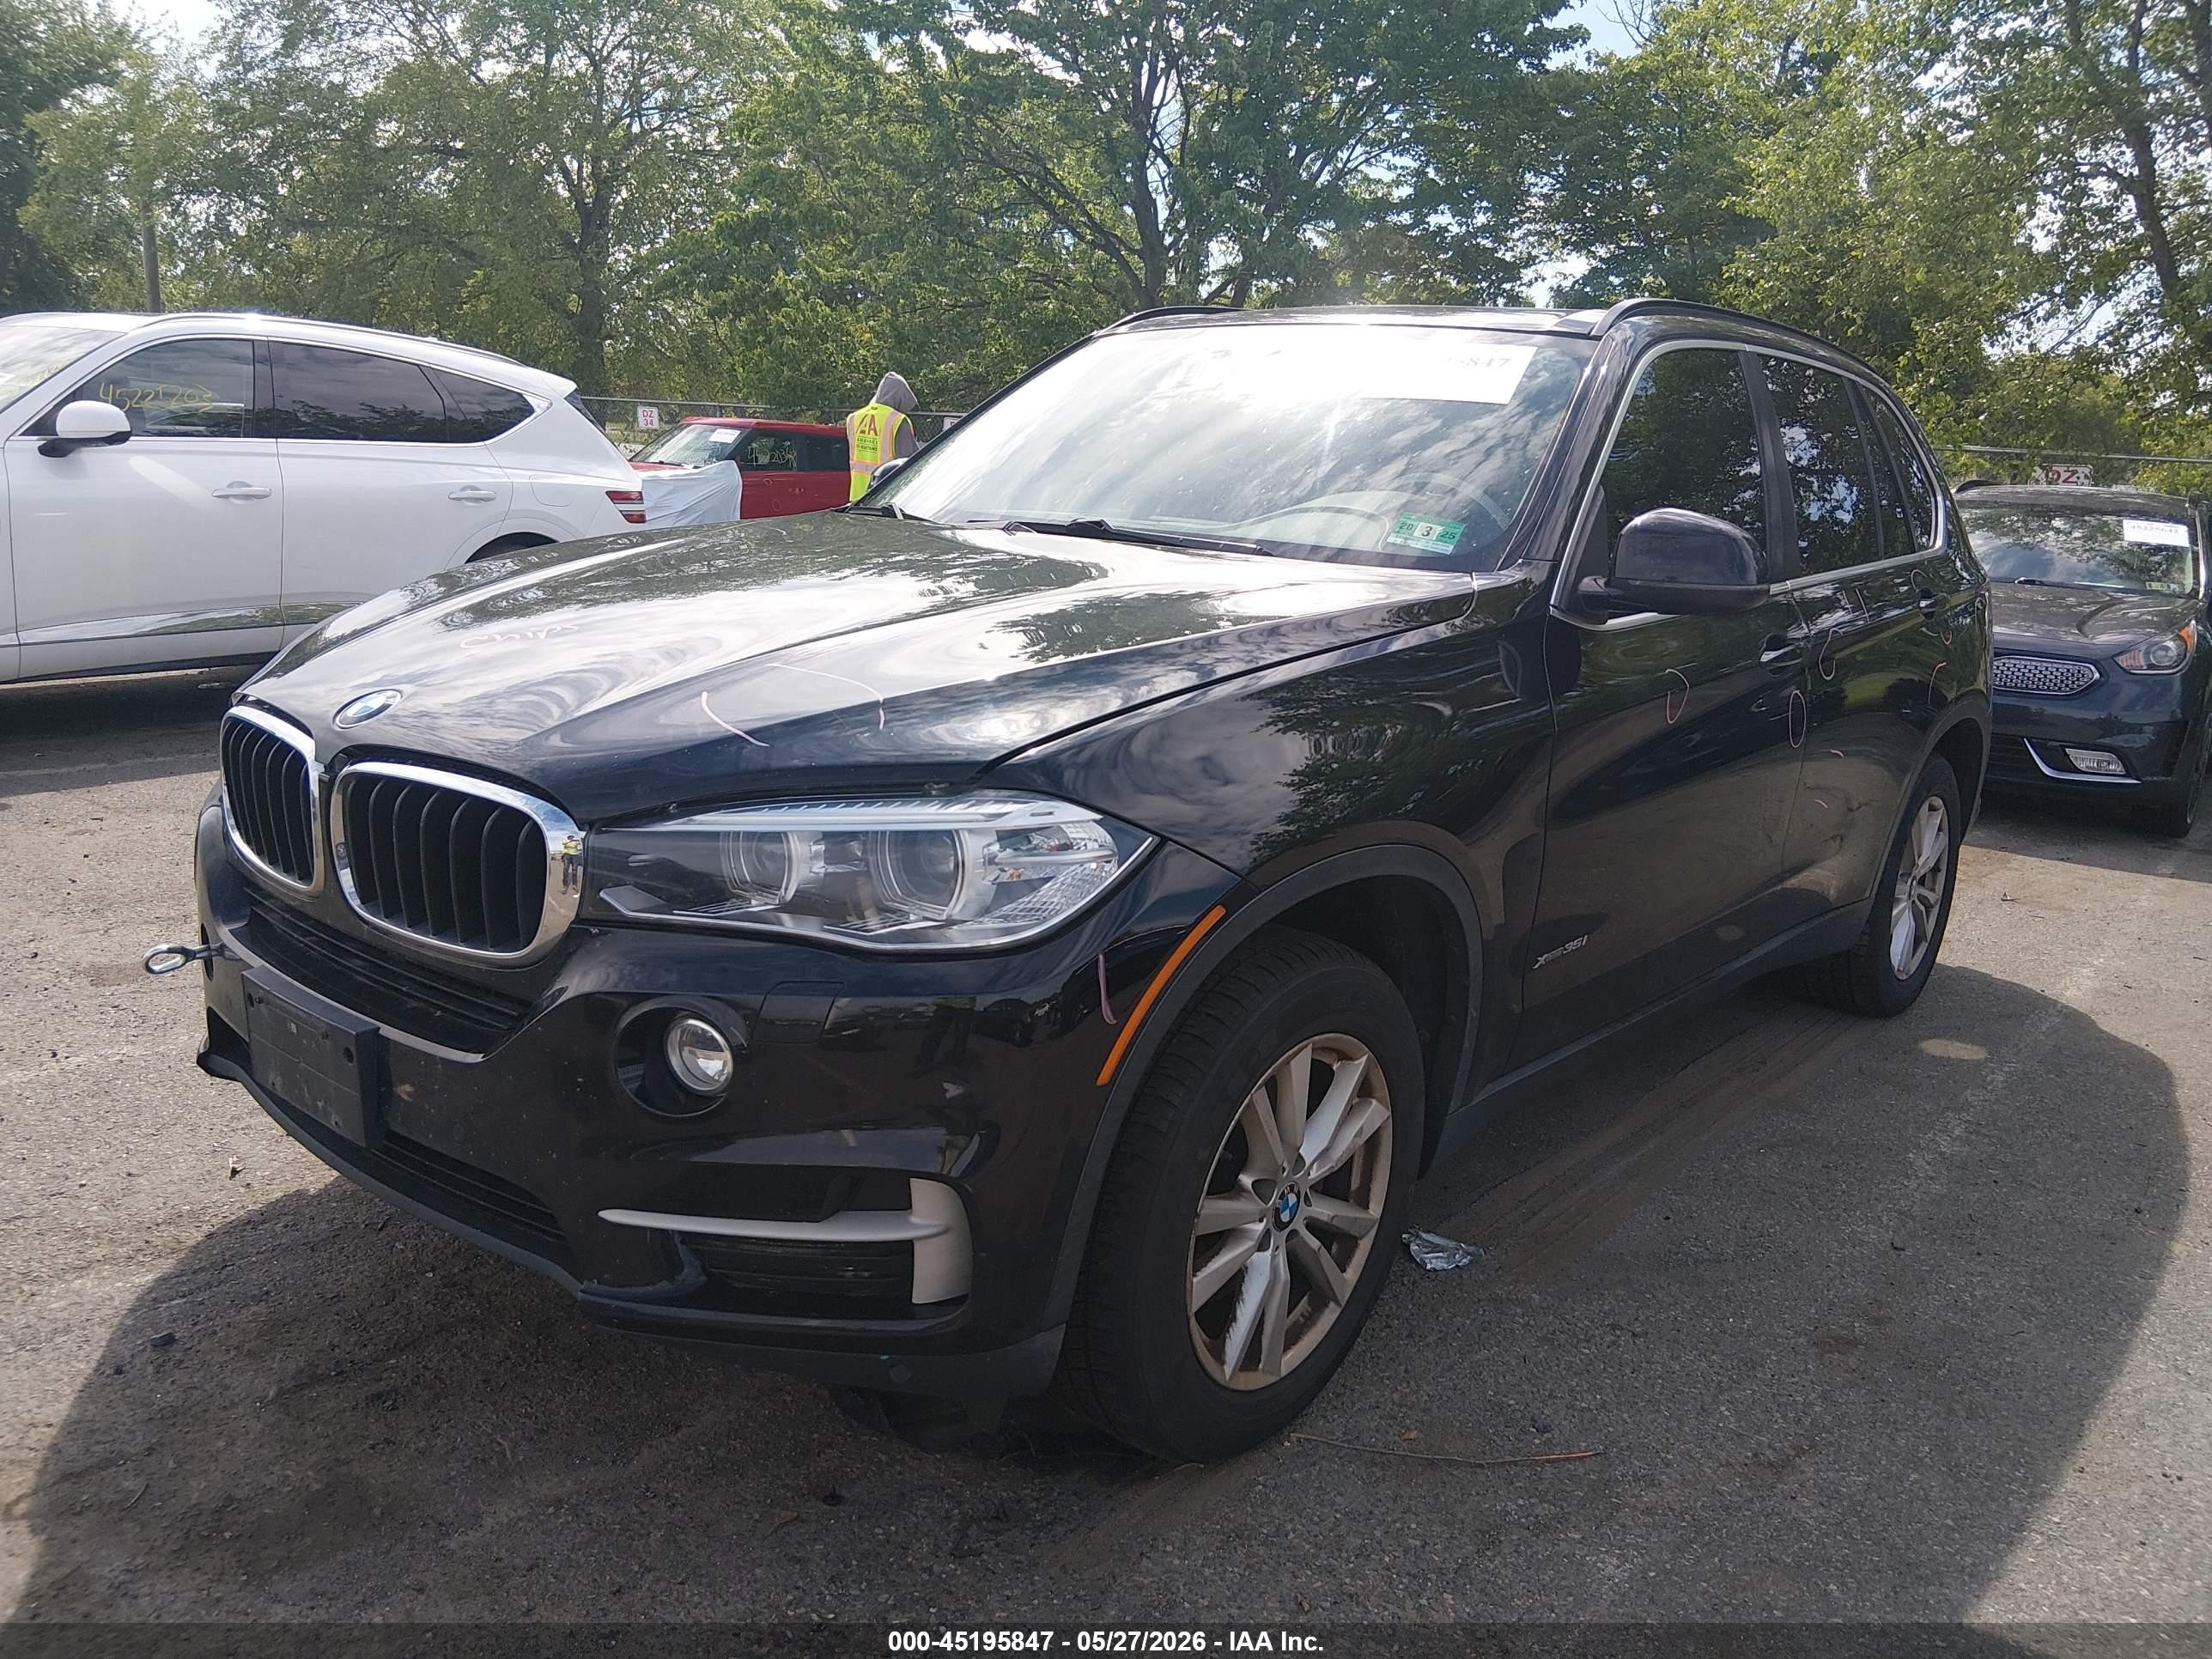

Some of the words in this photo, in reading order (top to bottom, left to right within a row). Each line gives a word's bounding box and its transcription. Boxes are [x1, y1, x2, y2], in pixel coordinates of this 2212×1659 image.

[642, 410, 653, 418] DZ
[1400, 522, 1413, 531] 20
[1421, 526, 1433, 538] 3
[1440, 531, 1455, 540] 25
